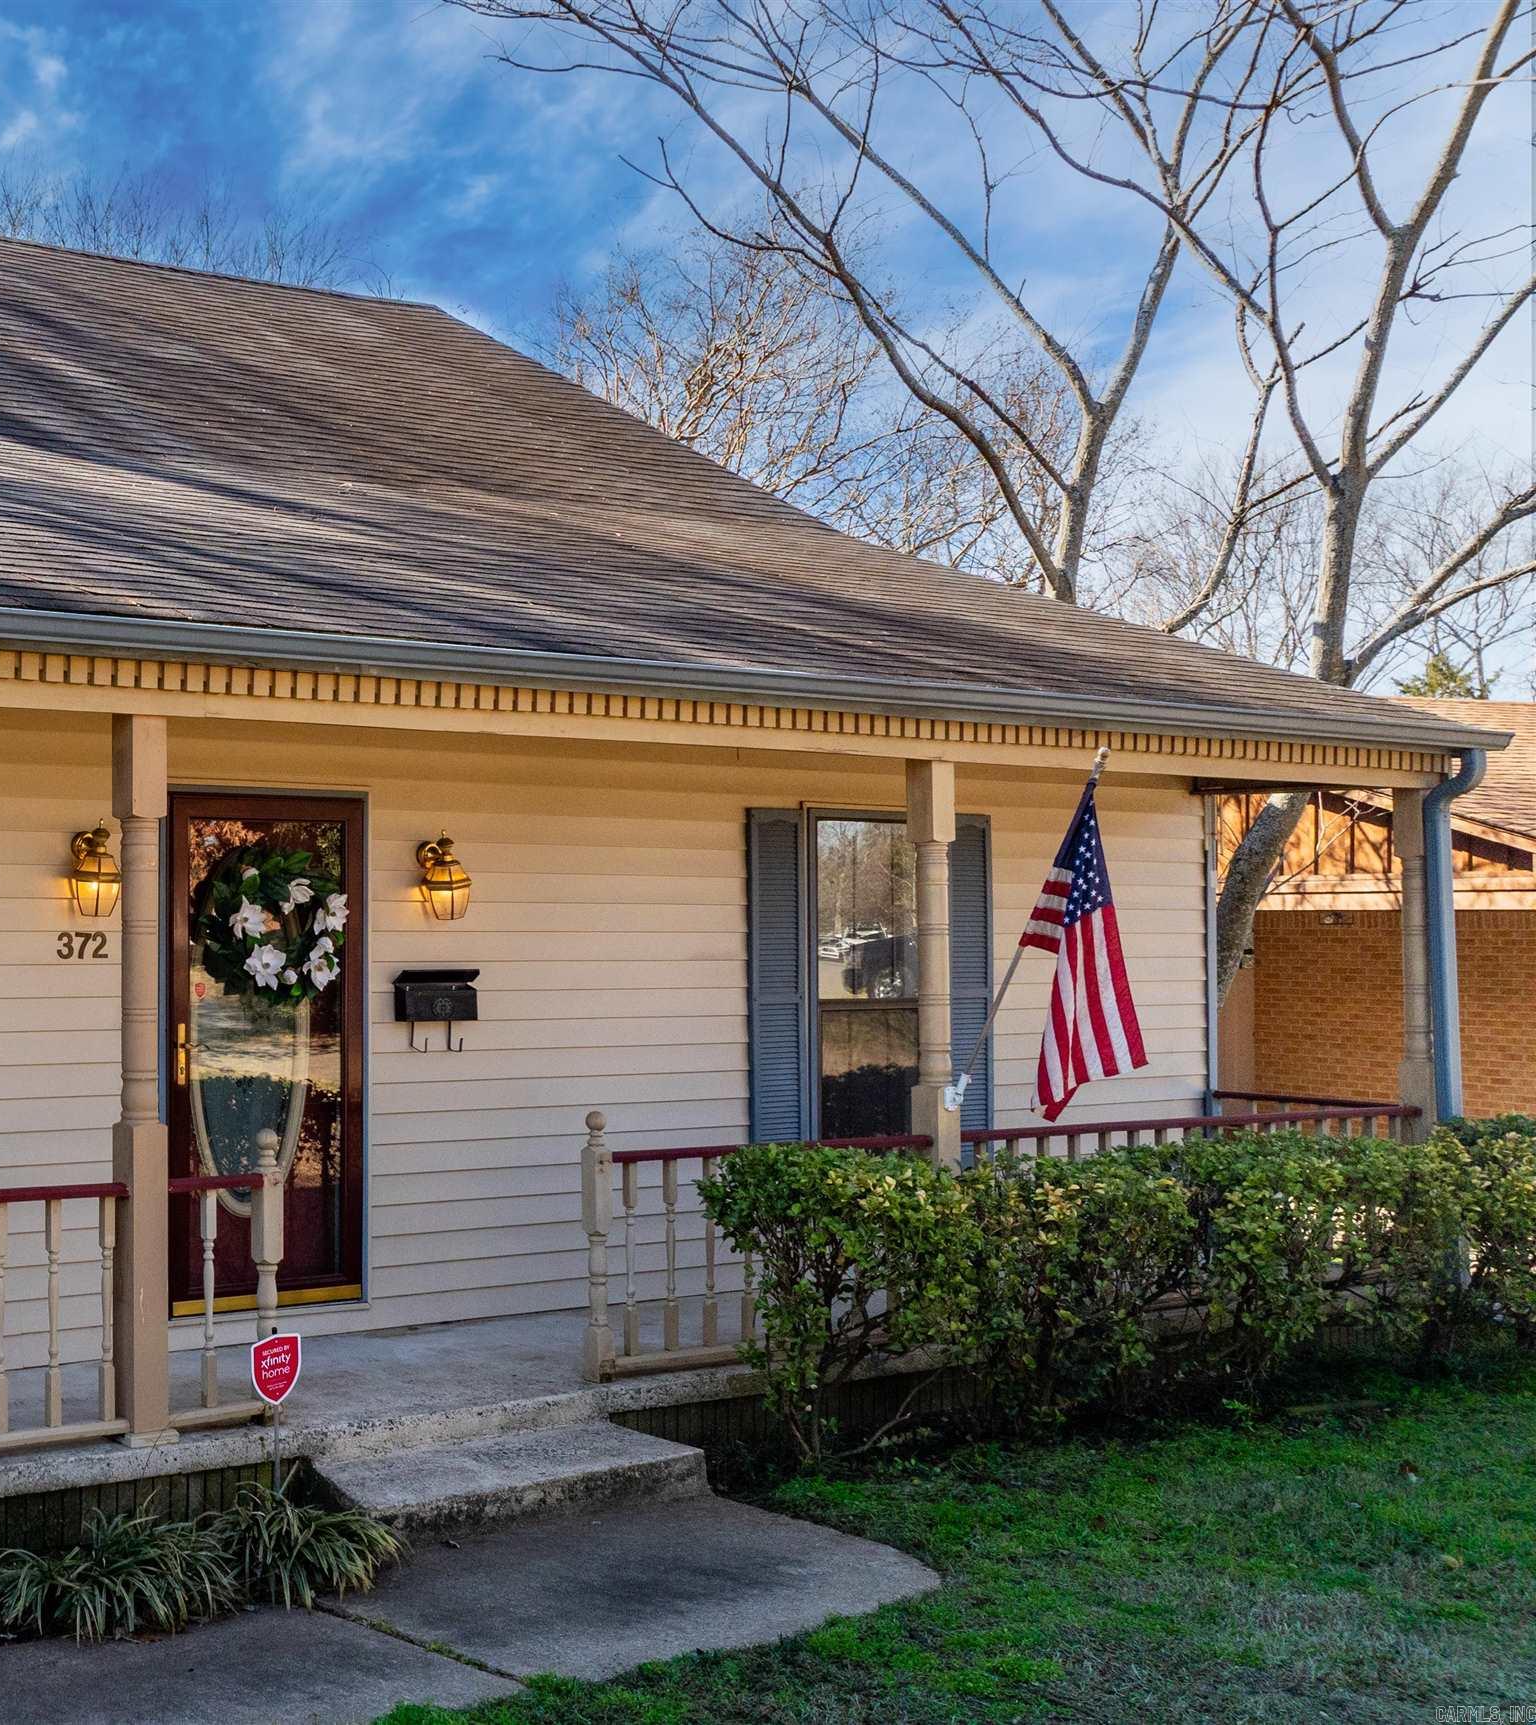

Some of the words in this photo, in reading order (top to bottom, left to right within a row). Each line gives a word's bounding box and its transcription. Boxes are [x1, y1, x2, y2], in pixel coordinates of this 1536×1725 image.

[56, 931, 109, 960] 372
[261, 1353, 291, 1370] xfinity
[262, 1365, 290, 1380] home
